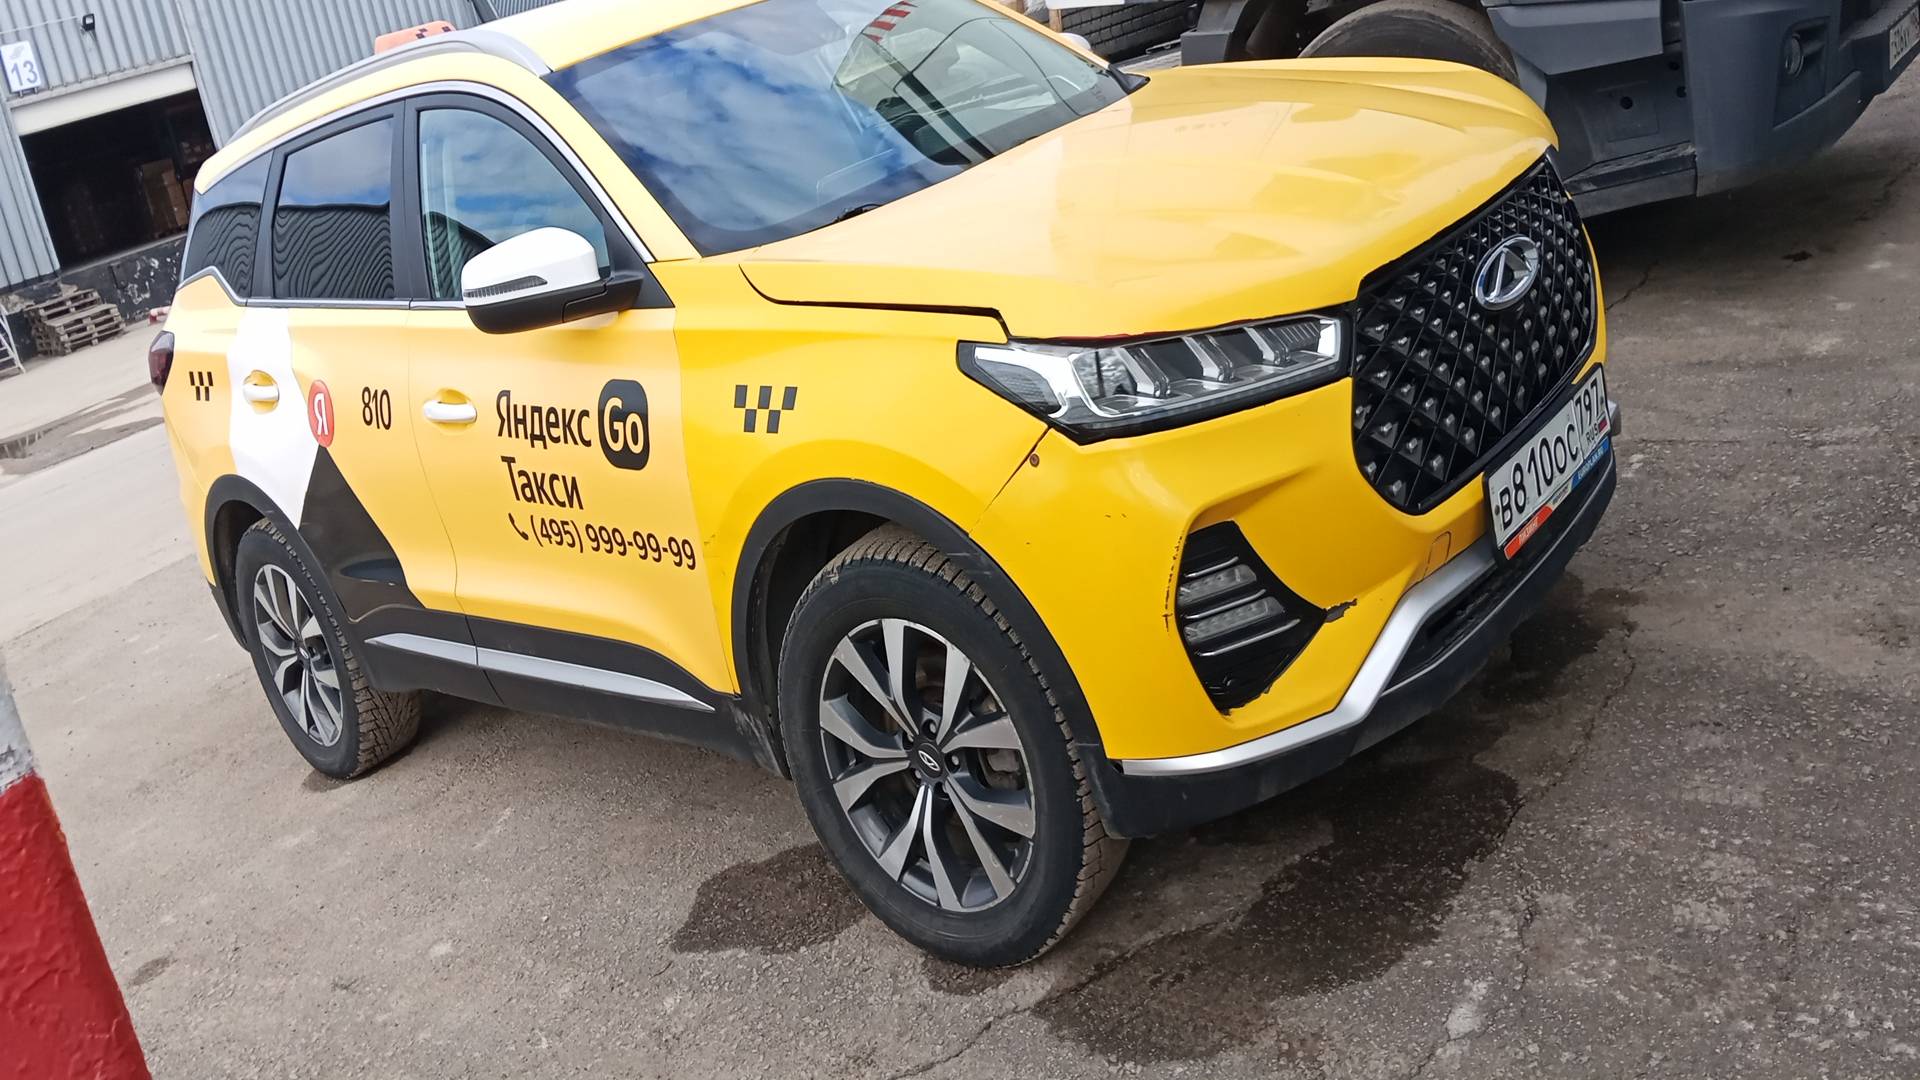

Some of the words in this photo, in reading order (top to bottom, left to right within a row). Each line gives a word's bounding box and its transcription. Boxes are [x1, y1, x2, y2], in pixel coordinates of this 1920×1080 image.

[11, 60, 38, 86] 13
[313, 392, 329, 436] Я
[361, 386, 392, 430] 810
[496, 389, 592, 450] Яндекс
[603, 396, 645, 455] Go
[1574, 378, 1600, 435] 797
[1585, 422, 1600, 446] RUS
[500, 455, 584, 511] Такси
[530, 514, 584, 554] (495)
[584, 522, 697, 571] 999-99-99
